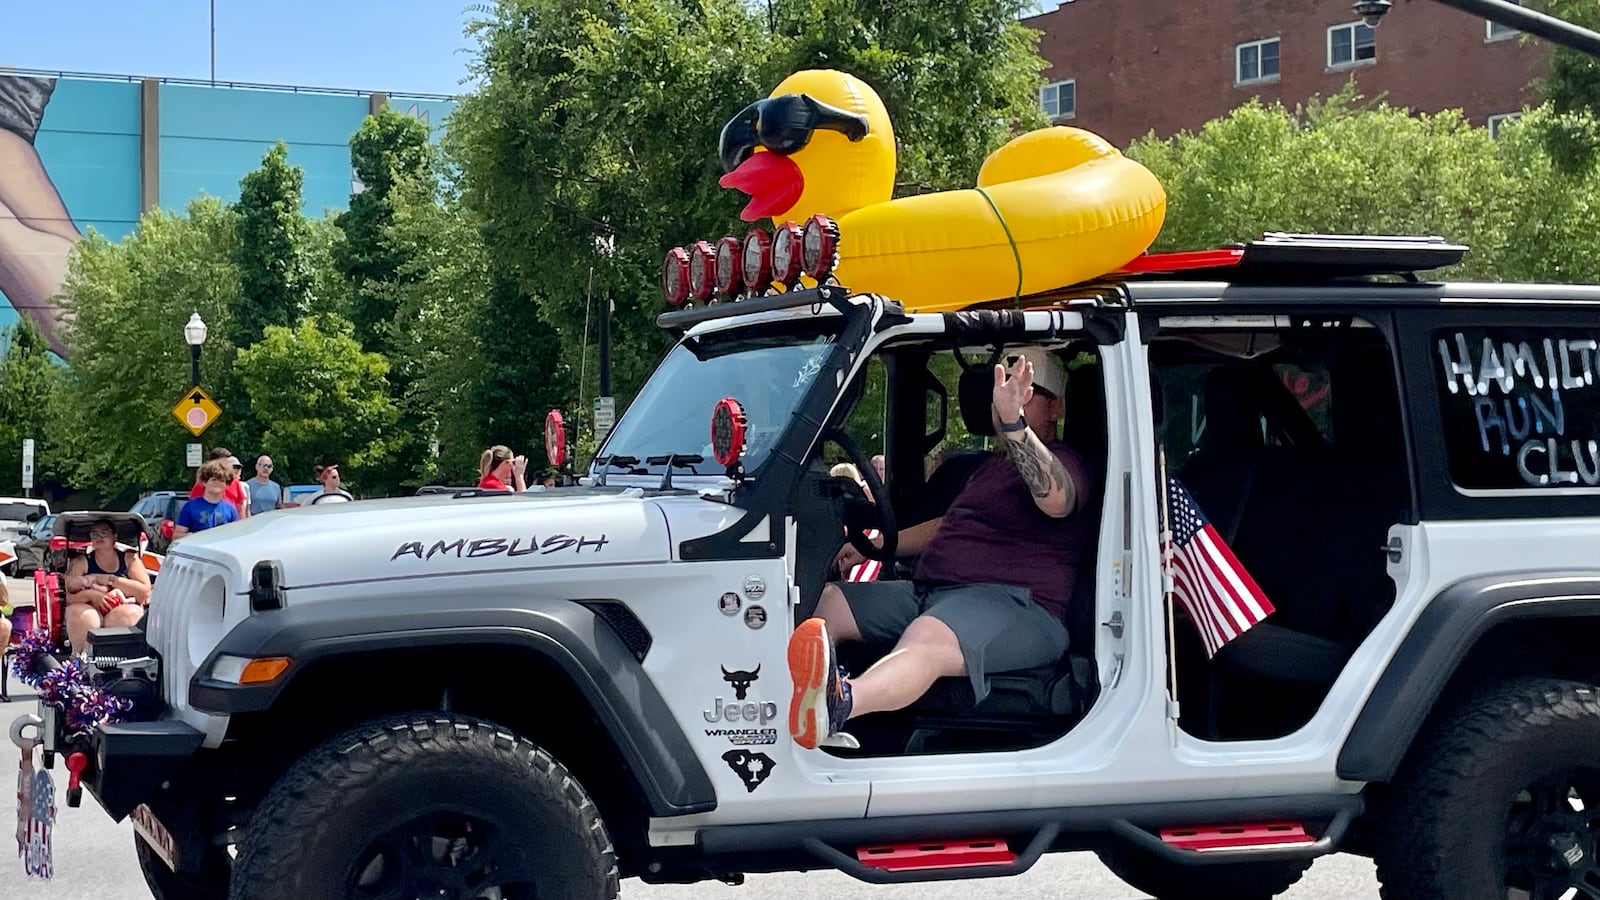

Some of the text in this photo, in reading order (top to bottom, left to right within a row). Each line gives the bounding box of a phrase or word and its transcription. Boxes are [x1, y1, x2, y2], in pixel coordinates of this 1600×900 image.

[1438, 333, 1600, 395] HAMILT
[1475, 389, 1564, 455] RUN
[1517, 437, 1600, 484] CLU
[391, 534, 609, 561] AMBUSH
[704, 697, 777, 725] Jeep
[704, 728, 777, 736] WRANGLER
